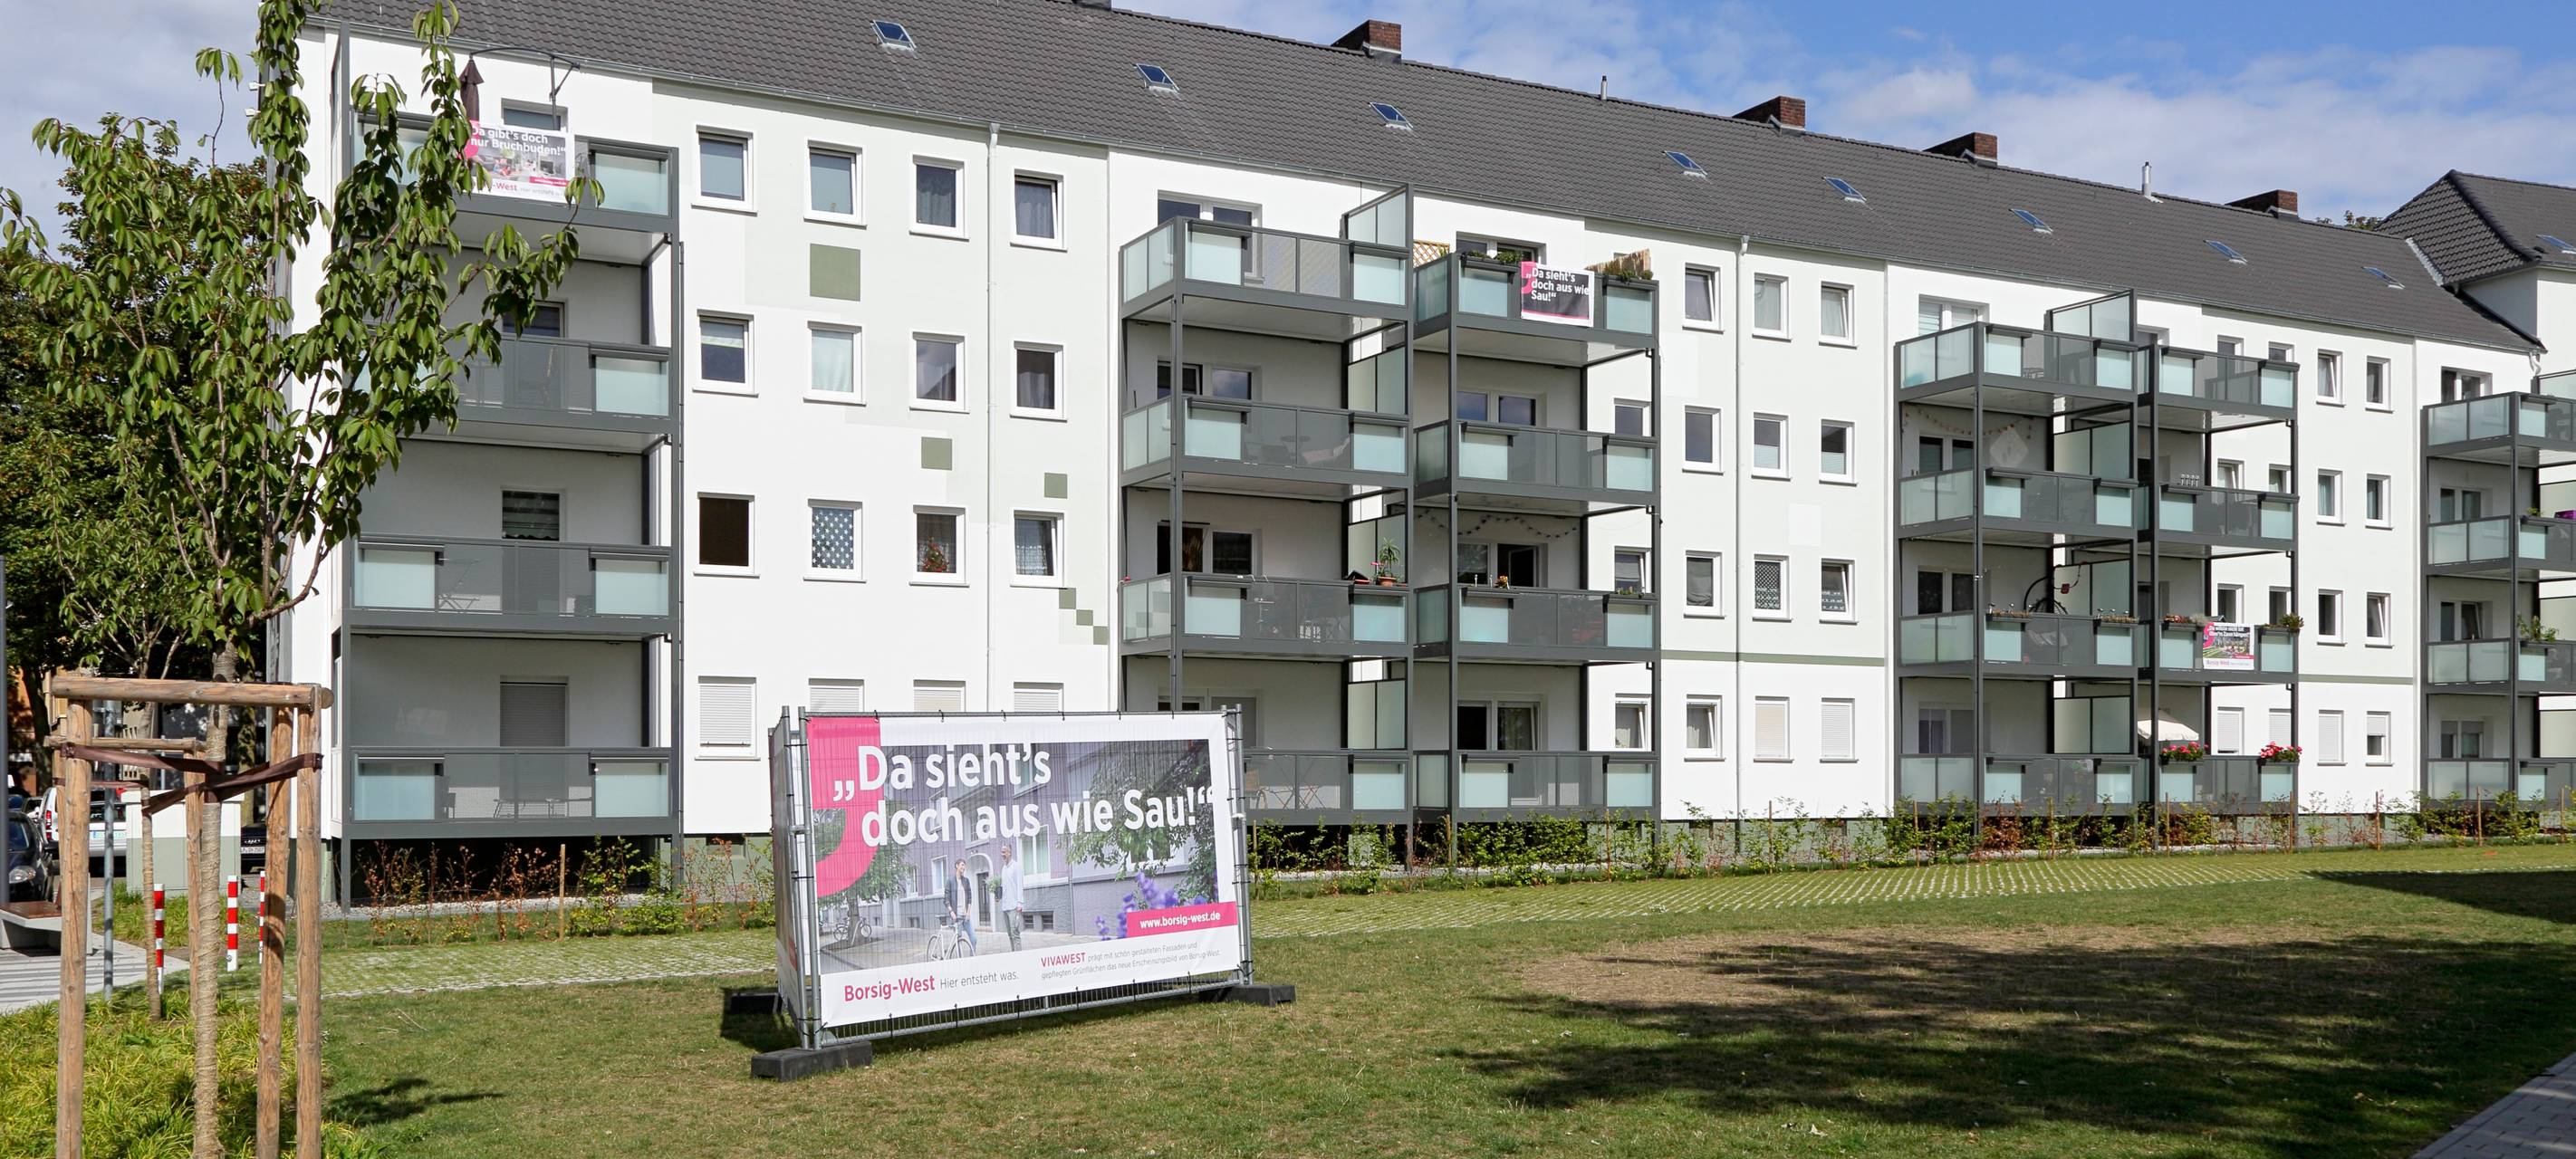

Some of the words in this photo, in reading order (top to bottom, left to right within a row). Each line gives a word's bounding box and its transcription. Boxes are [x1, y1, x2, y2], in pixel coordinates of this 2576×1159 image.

[471, 138, 489, 147] nur
[487, 129, 519, 141] gibt’s
[521, 133, 548, 144] doch
[1545, 270, 1576, 283] sieht’s
[1531, 279, 1554, 291] doch
[1556, 283, 1572, 292] aus
[1574, 285, 1590, 295] wie
[1531, 290, 1557, 302] Sau!“
[832, 745, 914, 801] „Da
[926, 742, 1052, 789] sieht’s
[861, 797, 964, 847] doch
[976, 803, 1041, 838] aus
[1051, 790, 1114, 835] wie
[1123, 786, 1215, 830] Sau!“
[1139, 911, 1221, 929] www.borsig-west.de
[1041, 953, 1086, 967] VIVAWEST
[1088, 953, 1103, 963] prägt
[1104, 952, 1113, 960] mit
[1114, 950, 1130, 958] schön
[1132, 946, 1161, 957] gestalteten
[1163, 943, 1187, 952] Fassaden
[1187, 942, 1197, 950] und
[1042, 969, 1072, 980] gepflegten
[1108, 963, 1117, 971] das
[844, 975, 936, 1001] Borsig-West
[940, 977, 958, 990] Hier
[961, 972, 997, 987] entsteht
[999, 971, 1020, 982] was.
